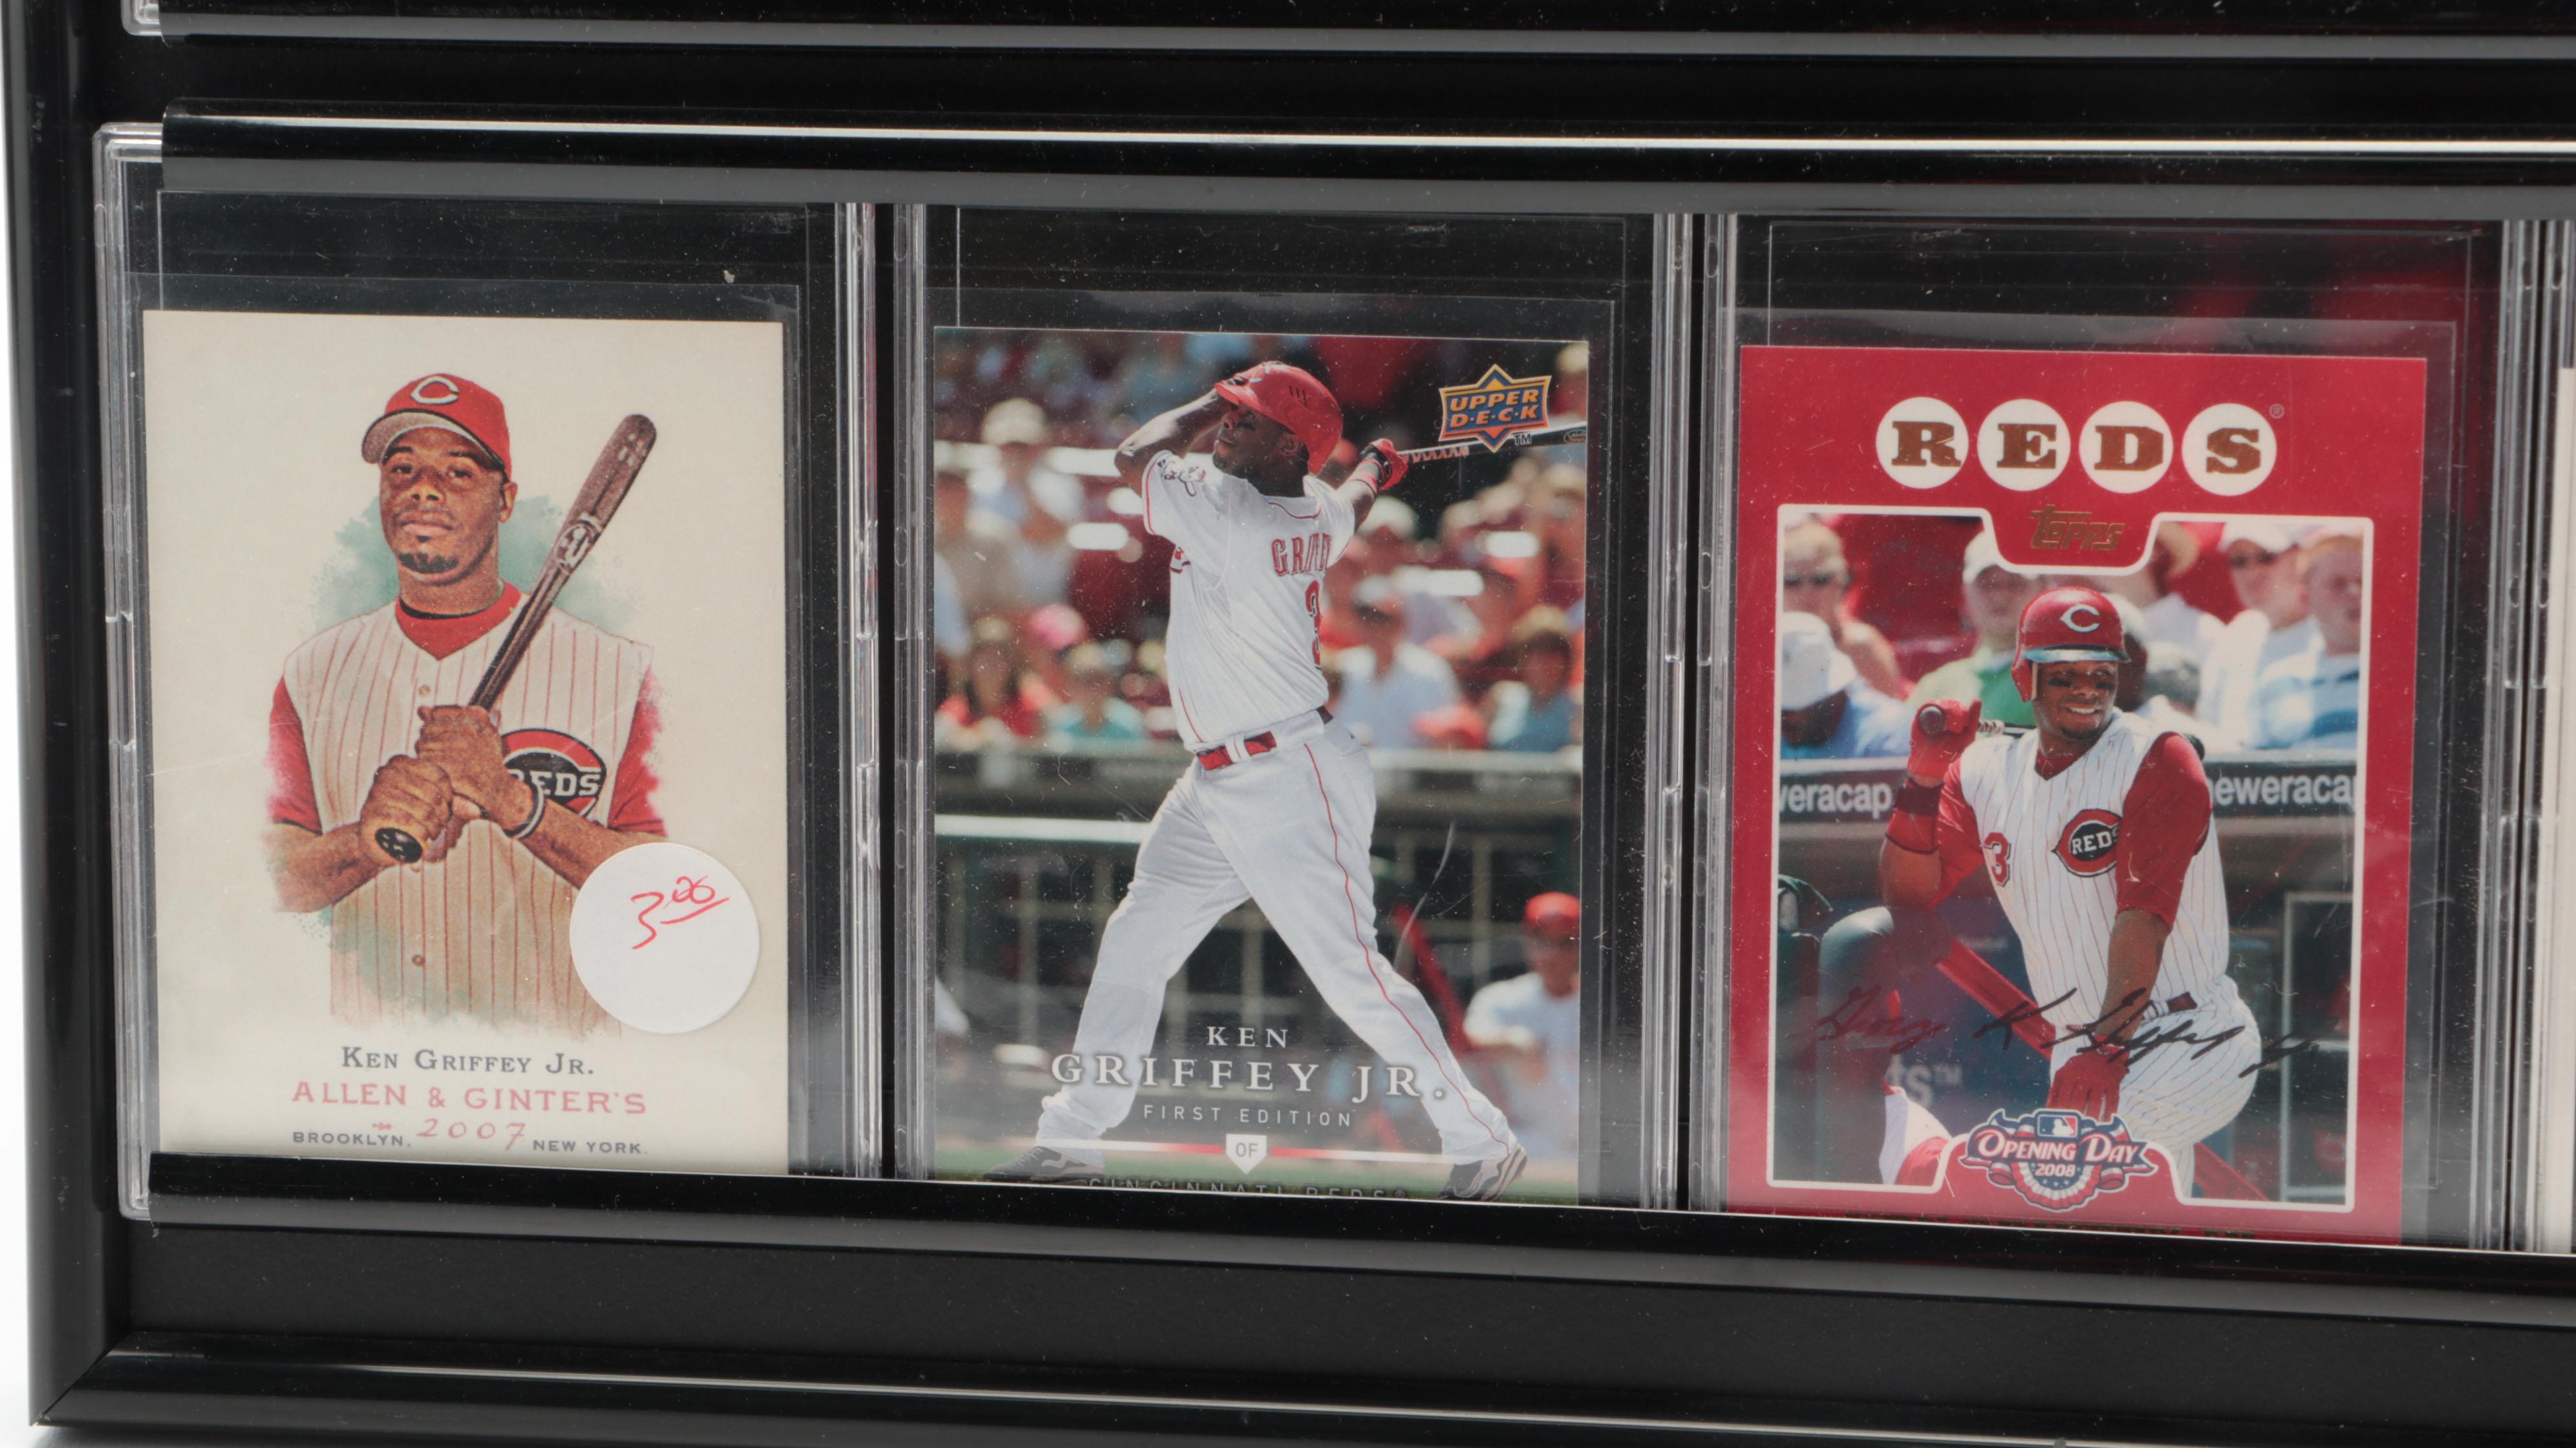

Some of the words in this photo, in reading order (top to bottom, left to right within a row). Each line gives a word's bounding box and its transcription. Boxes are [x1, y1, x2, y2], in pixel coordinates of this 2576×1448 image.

[411, 376, 459, 405] C
[1450, 389, 1540, 412] UPPER
[2059, 603, 2101, 633] C
[2209, 774, 2356, 805] eweraca
[1206, 1026, 1288, 1049] KEN
[1051, 1054, 1320, 1092] GRIFFEY
[1351, 1065, 1443, 1103] JR.
[291, 1081, 407, 1106] ALLEN
[428, 1086, 445, 1109] &
[464, 1087, 646, 1114] GINTER'S
[1144, 1104, 1221, 1122] FIRST
[1240, 1109, 1351, 1127] EDITION
[416, 1118, 526, 1151] 2007
[532, 1139, 576, 1153] NEW
[1235, 1142, 1258, 1157] OF
[2035, 1163, 2076, 1178] 2008
